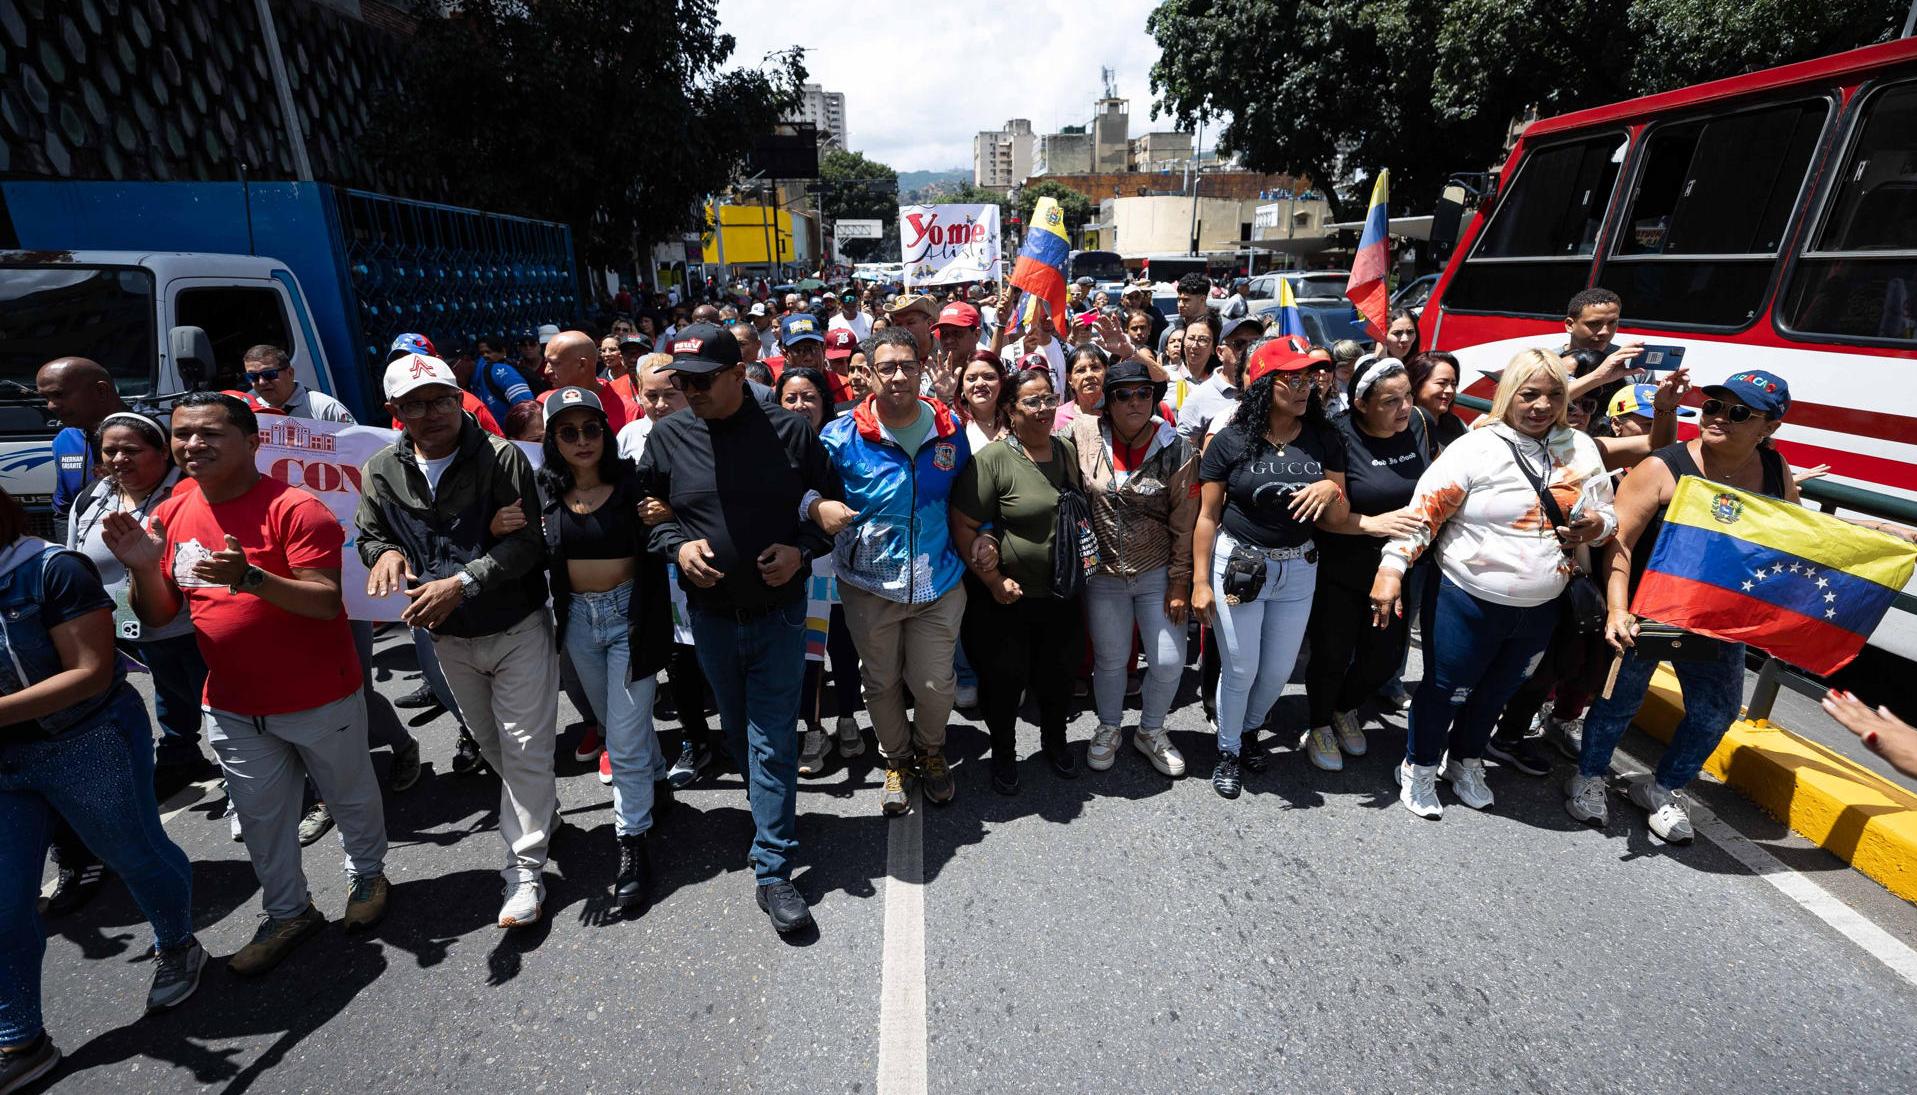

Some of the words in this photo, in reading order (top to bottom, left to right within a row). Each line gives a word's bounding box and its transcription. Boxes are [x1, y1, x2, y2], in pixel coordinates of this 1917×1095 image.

[906, 213, 943, 248] Yo
[947, 223, 985, 245] me
[1398, 452, 1416, 463] Good
[1250, 461, 1323, 475] GUCCI
